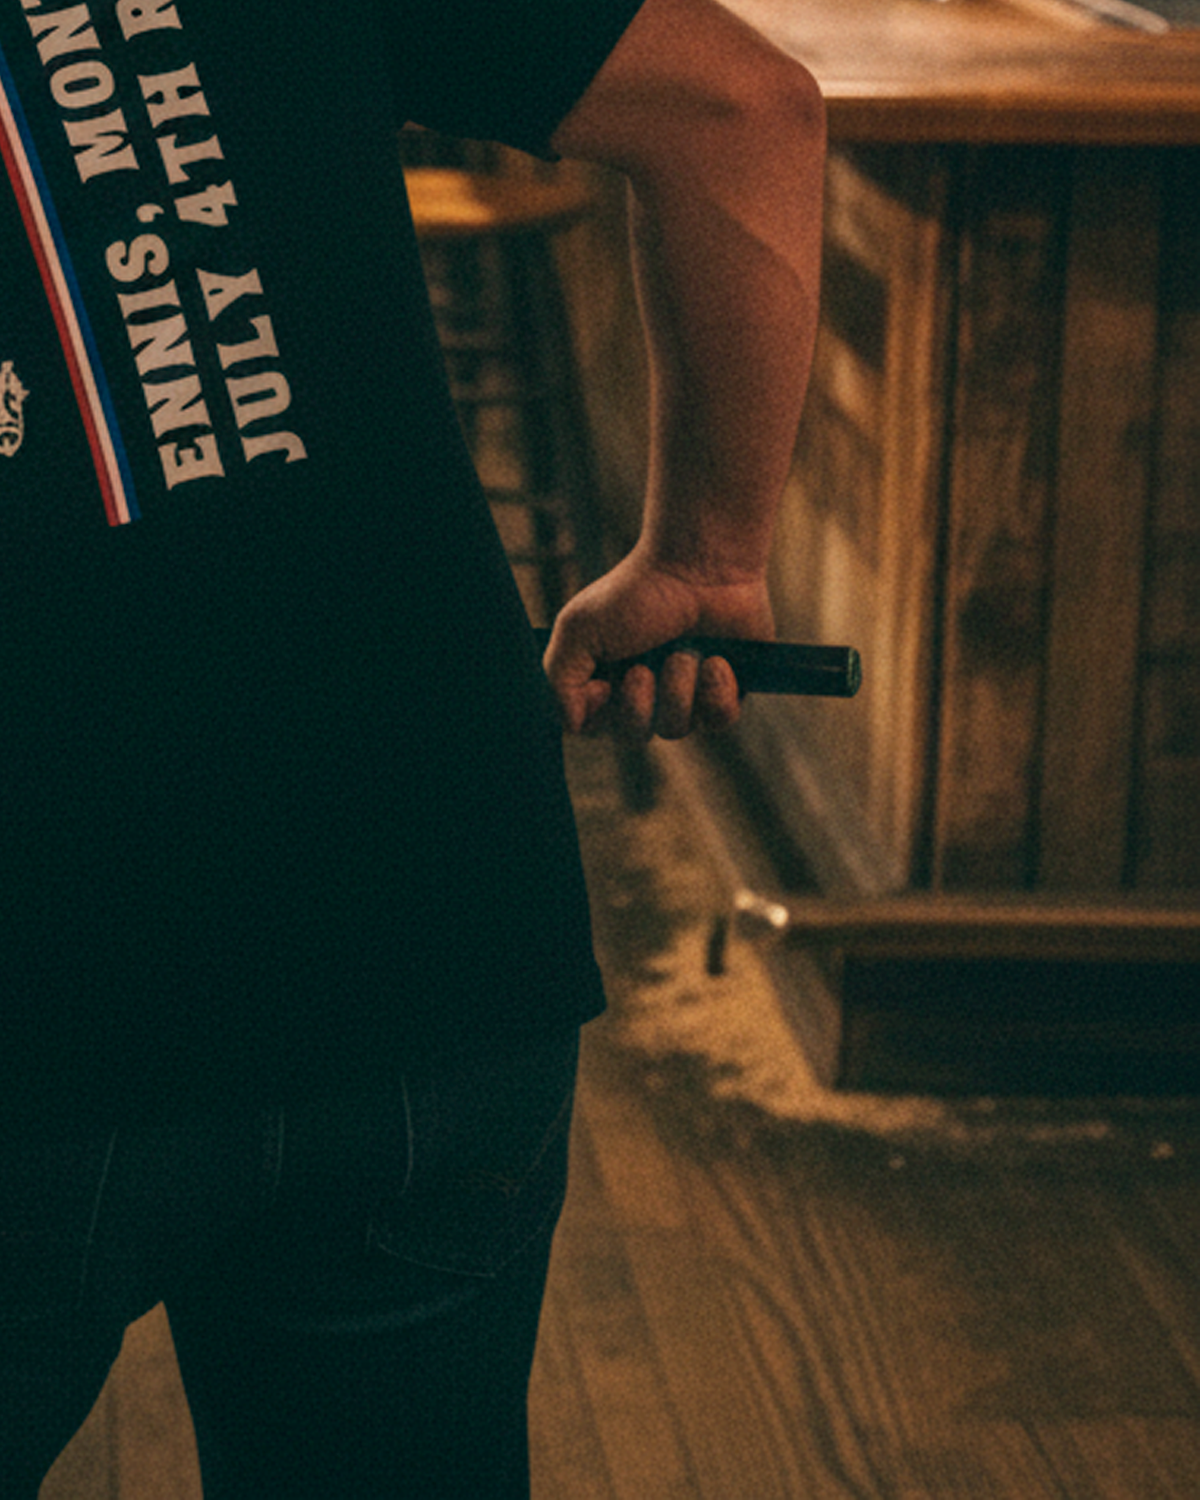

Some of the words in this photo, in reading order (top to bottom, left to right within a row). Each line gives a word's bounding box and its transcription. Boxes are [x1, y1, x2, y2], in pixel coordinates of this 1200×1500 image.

[137, 62, 238, 226] 4TH
[105, 204, 225, 490] ENNIS,
[197, 269, 307, 463] JULY
